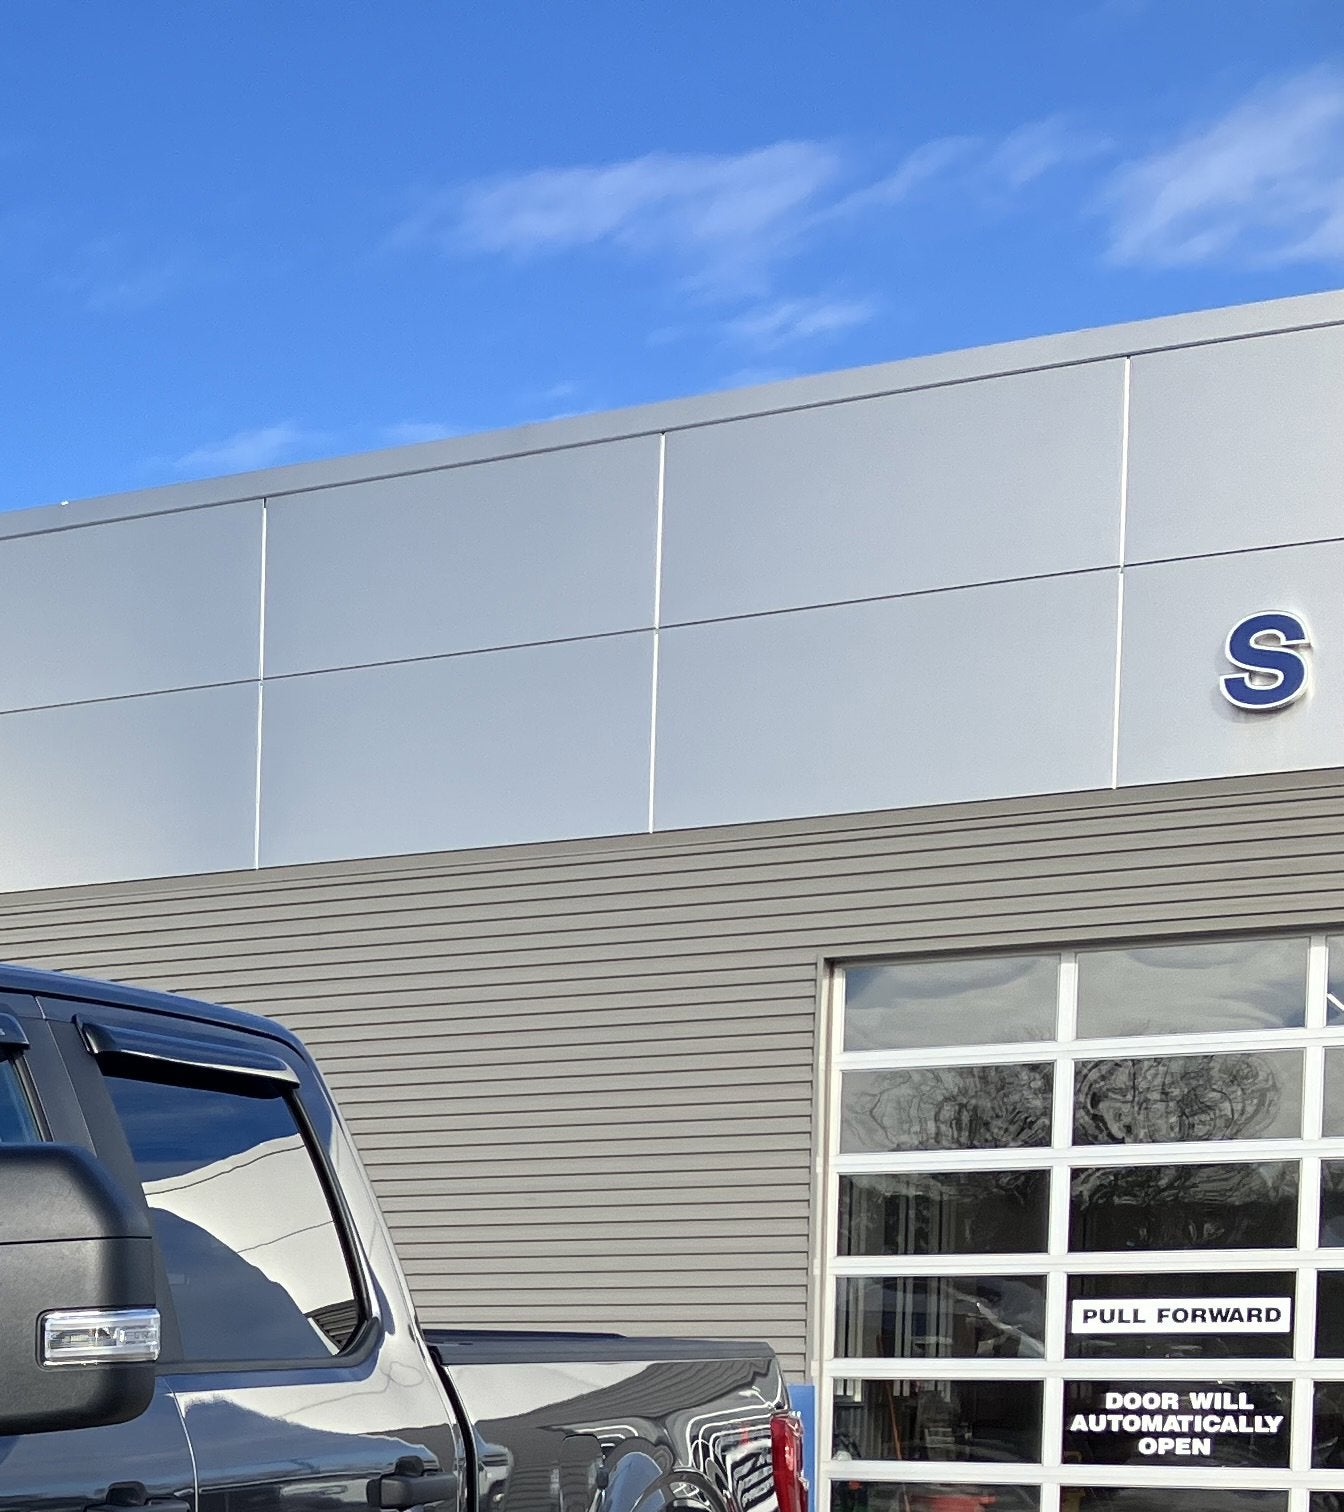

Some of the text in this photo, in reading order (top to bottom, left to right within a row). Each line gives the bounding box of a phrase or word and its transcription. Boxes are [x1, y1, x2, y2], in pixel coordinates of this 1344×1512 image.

[1220, 610, 1308, 709] S
[1083, 1307, 1282, 1324] PULL FORWARD
[1105, 1392, 1254, 1410] DOOR WILL
[1070, 1414, 1284, 1433] AUTOMATICALLY
[1138, 1437, 1211, 1455] OPEN
